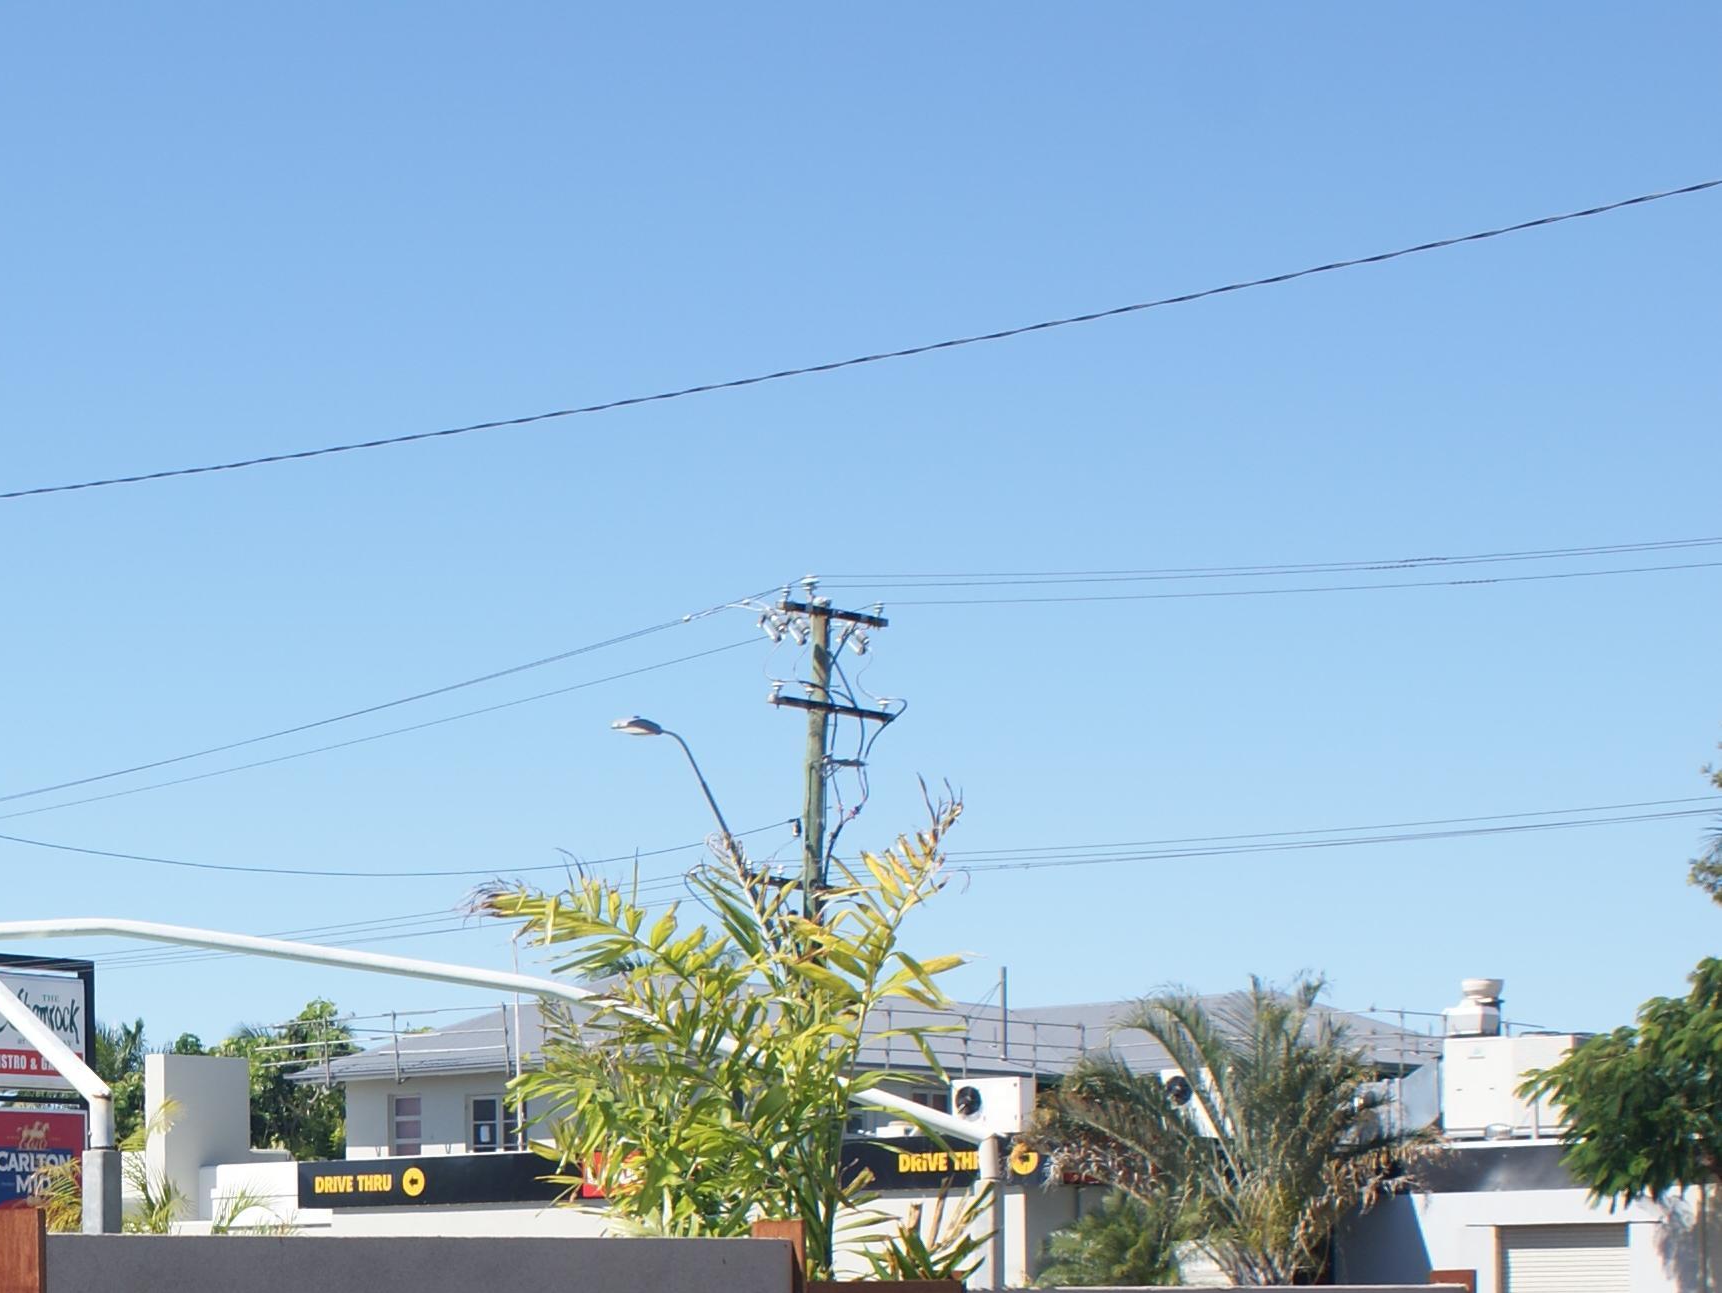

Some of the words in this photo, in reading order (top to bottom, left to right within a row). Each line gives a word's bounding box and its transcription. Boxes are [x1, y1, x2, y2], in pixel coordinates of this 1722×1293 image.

[30, 1058, 38, 1071] &
[952, 1151, 979, 1171] TH
[16, 1174, 53, 1195] MID
[314, 1176, 353, 1193] DRIVE
[356, 1174, 392, 1191] THRU
